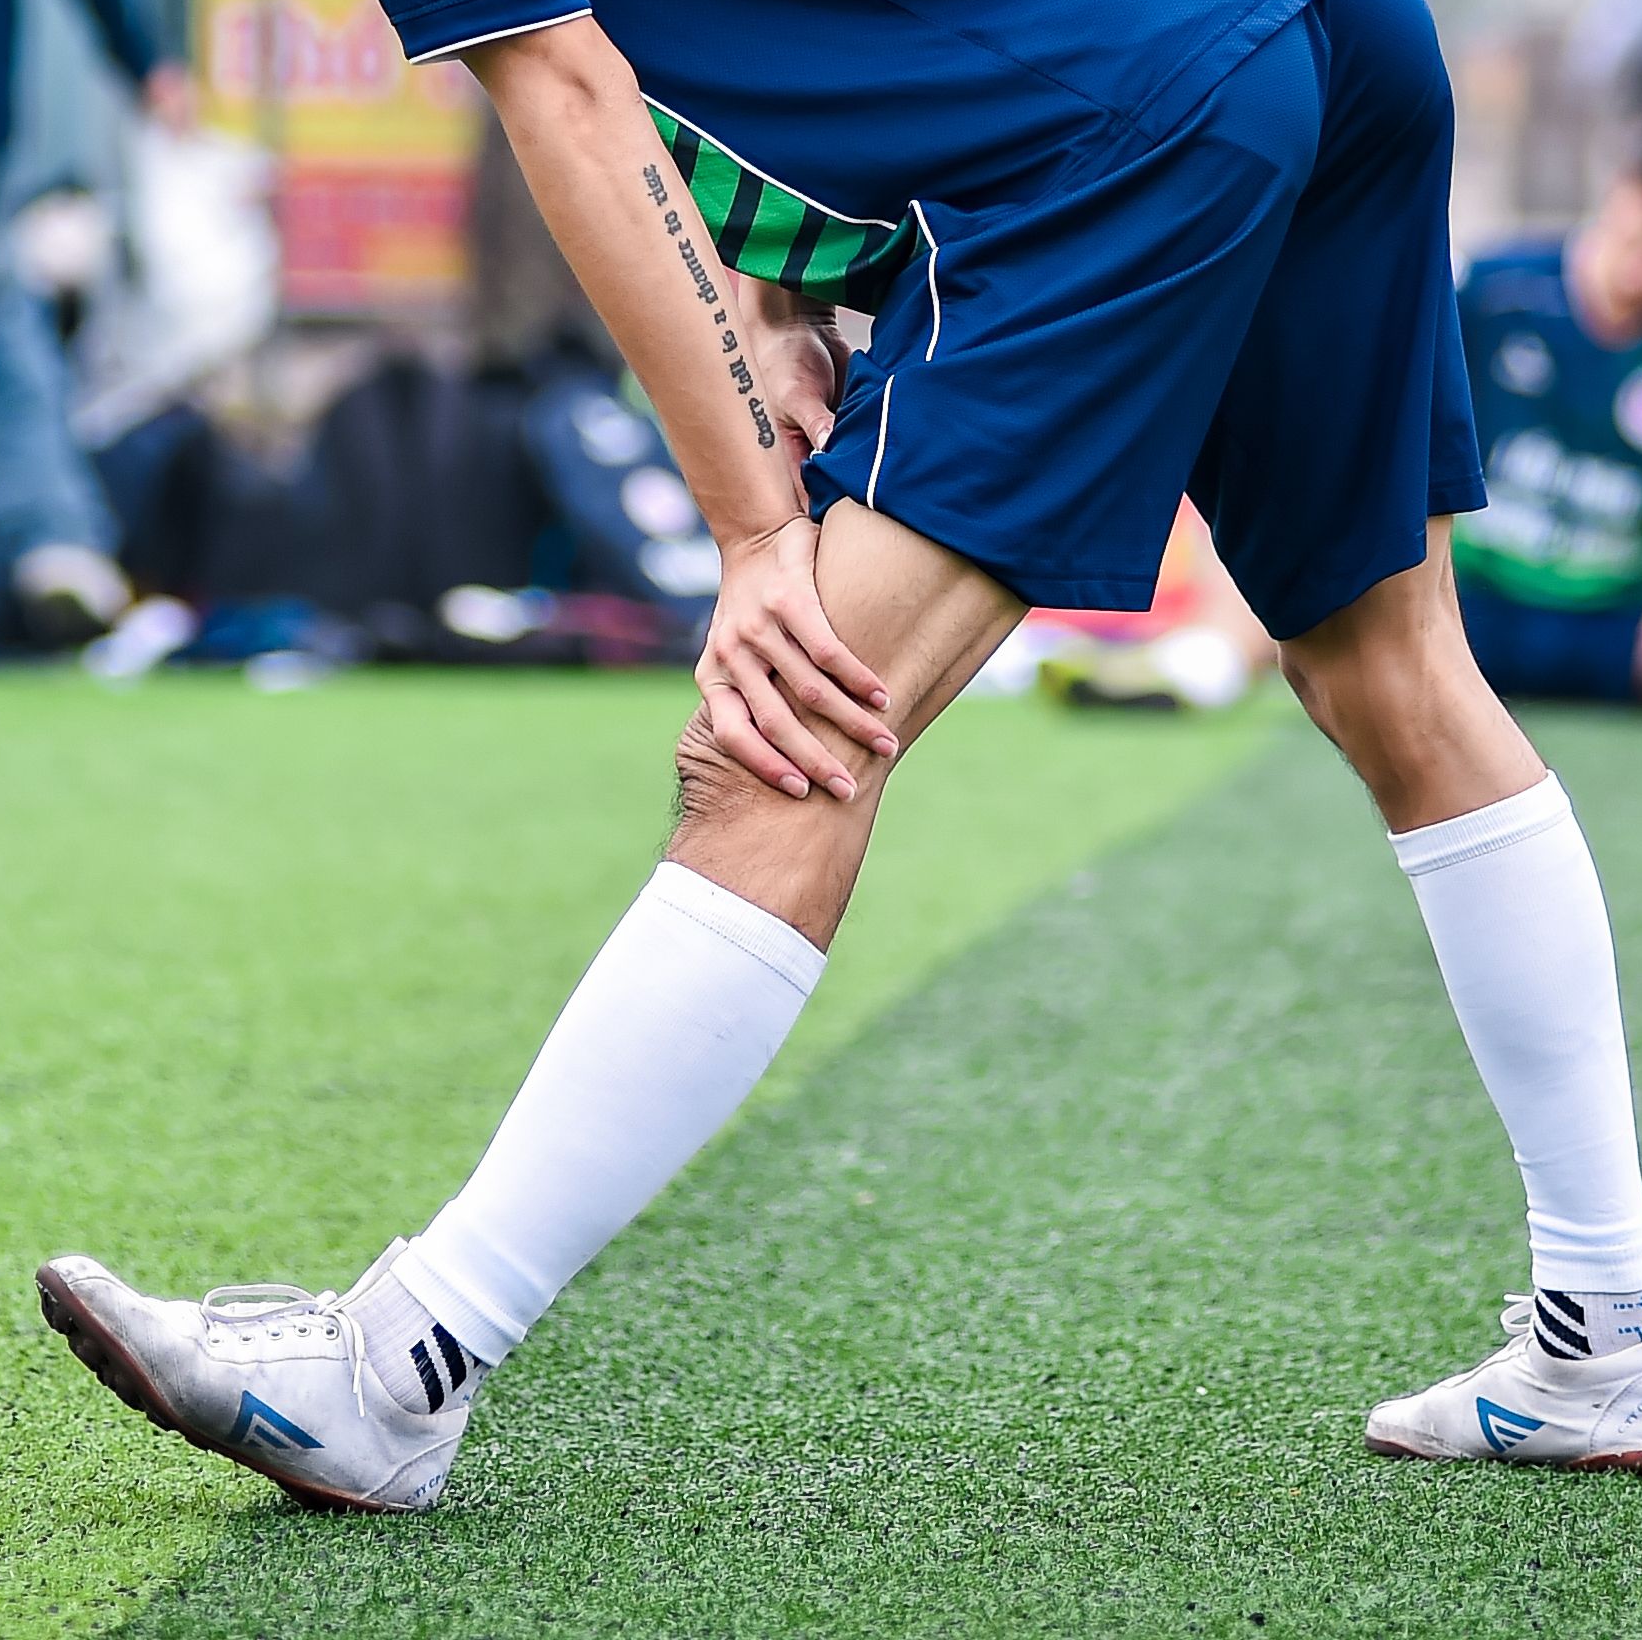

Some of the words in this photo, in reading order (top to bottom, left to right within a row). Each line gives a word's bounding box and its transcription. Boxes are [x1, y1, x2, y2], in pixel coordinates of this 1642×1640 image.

[665, 210, 682, 236] to
[678, 237, 718, 304] chance
[714, 309, 727, 325] a
[722, 329, 738, 353] is
[729, 354, 753, 394] fall
